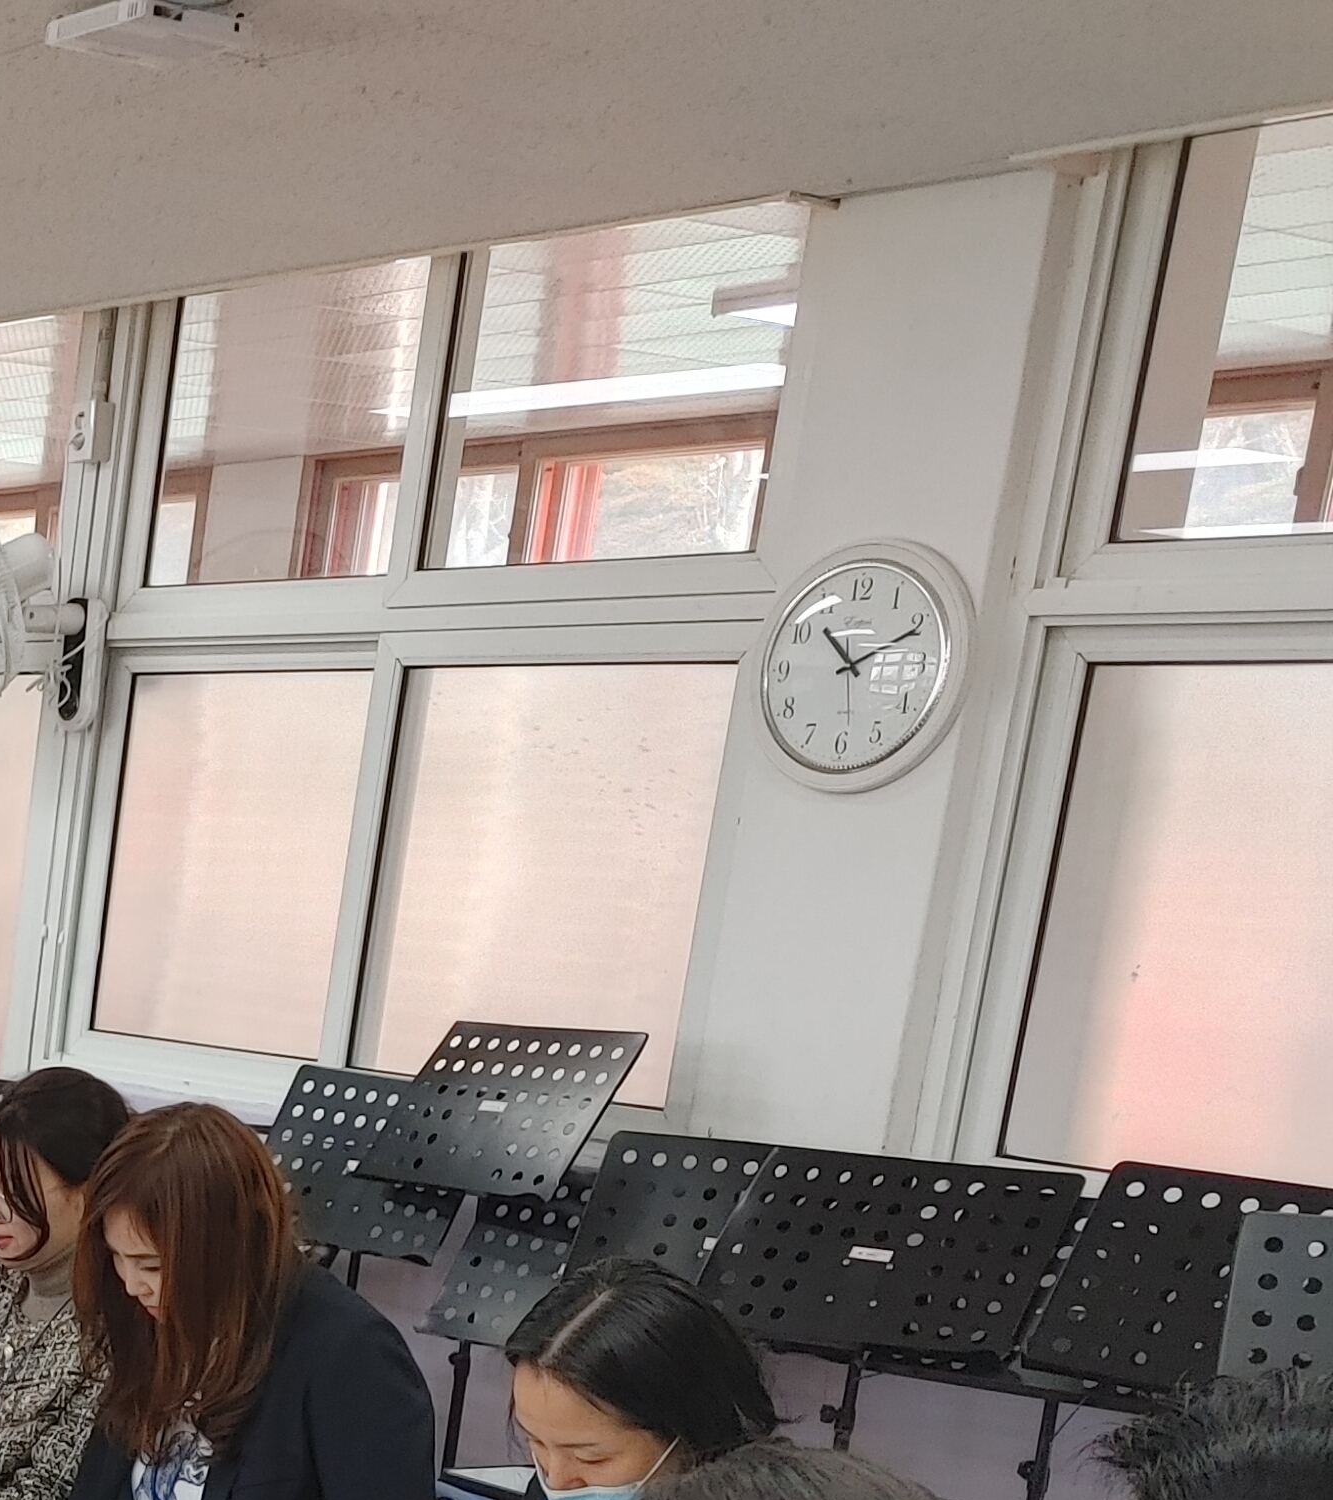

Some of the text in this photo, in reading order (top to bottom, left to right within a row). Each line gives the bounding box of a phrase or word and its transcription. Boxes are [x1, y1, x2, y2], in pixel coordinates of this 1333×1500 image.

[851, 577, 874, 601] 12
[892, 585, 900, 610] 1
[791, 620, 812, 645] 10
[911, 611, 925, 636] 2
[777, 659, 790, 683] 9
[783, 696, 795, 719] 8
[895, 692, 910, 714] 4
[803, 723, 816, 746] 7
[835, 731, 848, 755] 6
[868, 721, 882, 744] 5
